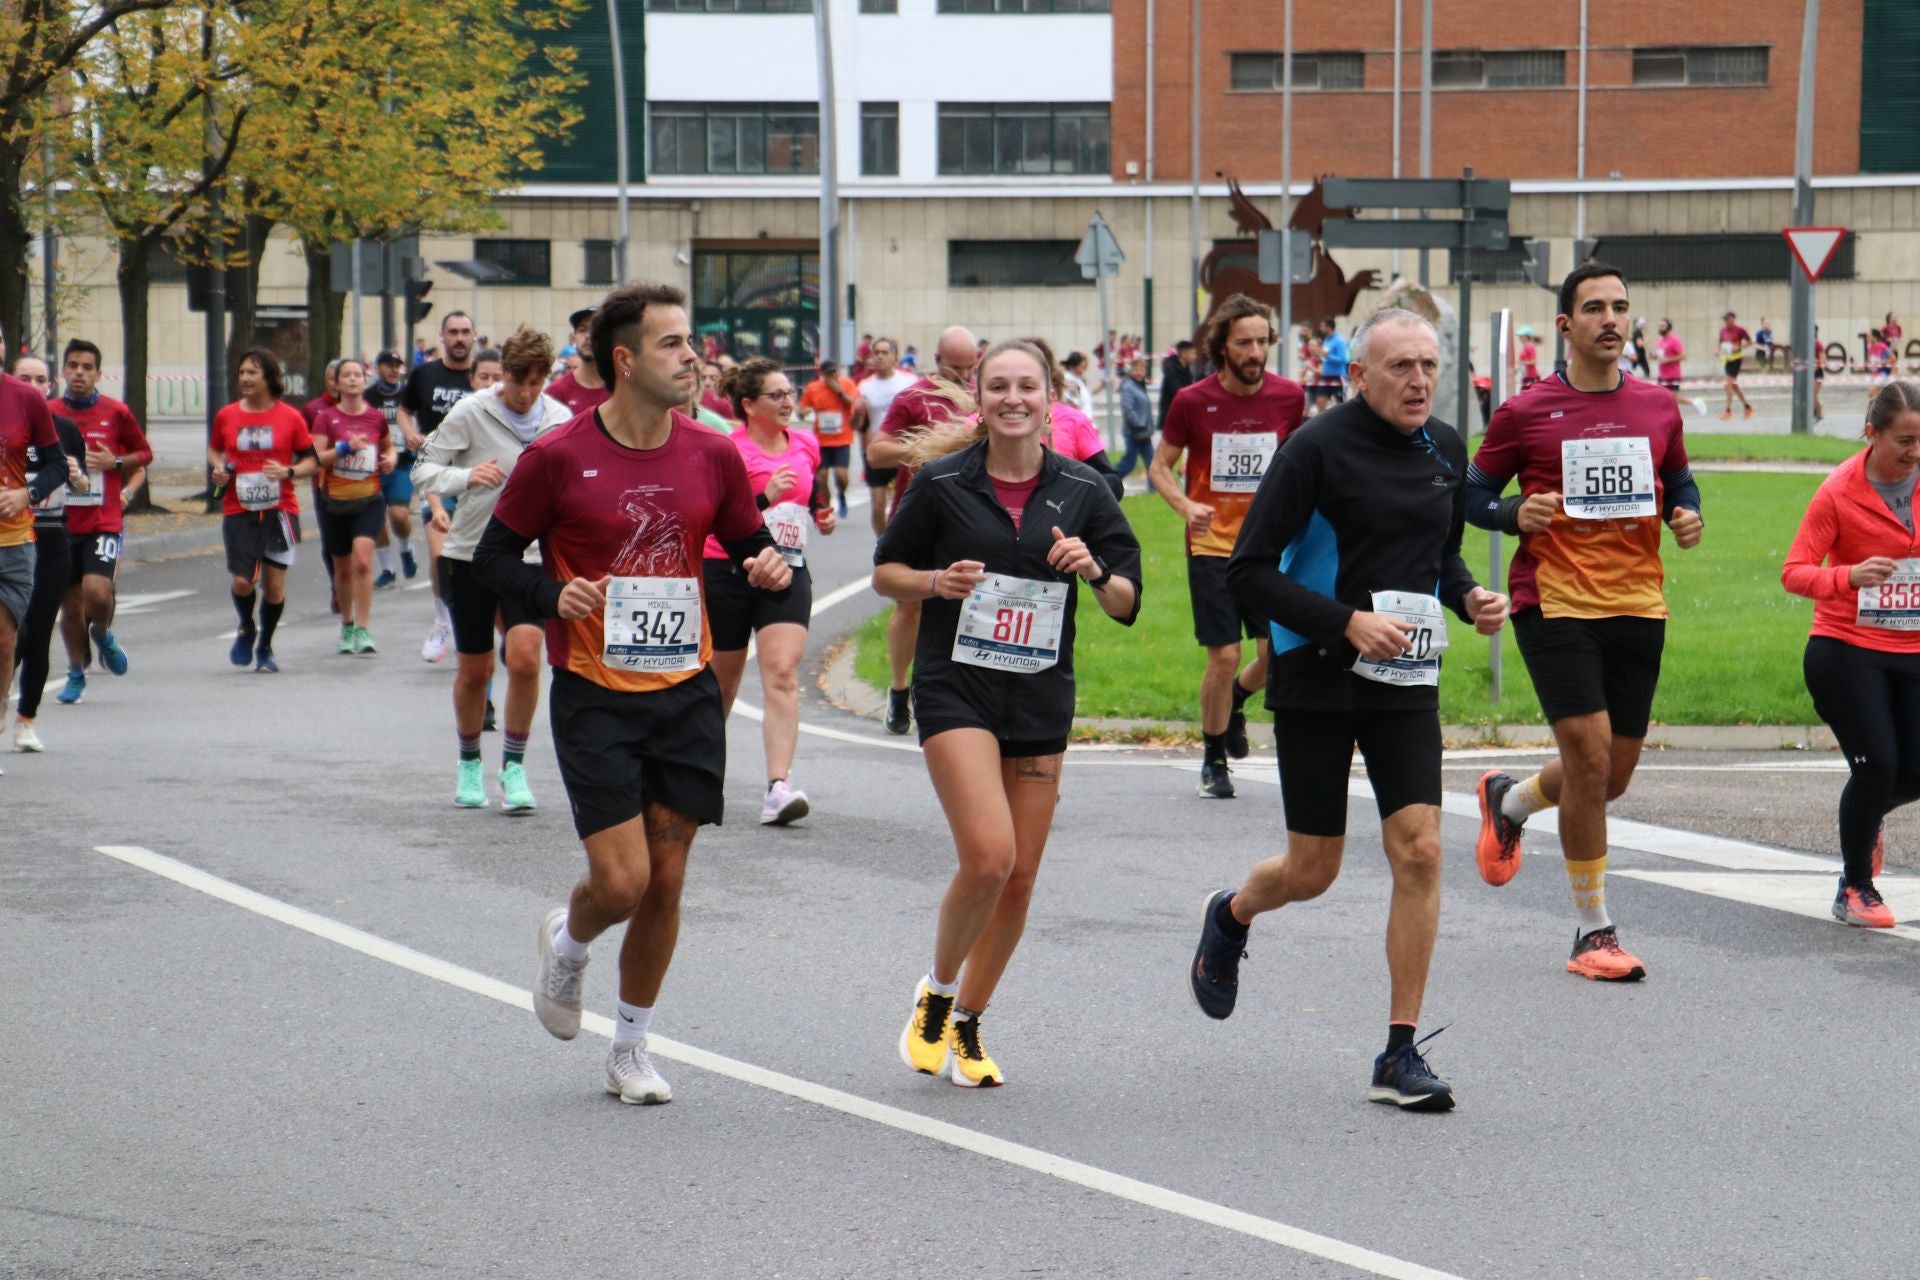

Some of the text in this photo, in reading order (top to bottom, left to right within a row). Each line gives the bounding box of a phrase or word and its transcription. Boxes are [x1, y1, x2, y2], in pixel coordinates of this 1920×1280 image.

[1228, 454, 1263, 475] 392
[1585, 465, 1633, 495] 568
[246, 486, 270, 500] 523
[1598, 503, 1640, 512] HYUNDAI
[776, 522, 799, 547] 769
[95, 536, 117, 559] 10
[648, 601, 671, 609] MIKEL
[1880, 583, 1920, 609] 858
[631, 610, 685, 645] 342
[992, 608, 1034, 646] 811
[643, 656, 686, 666] HYUNDAI
[993, 652, 1040, 668] HYUNDAI
